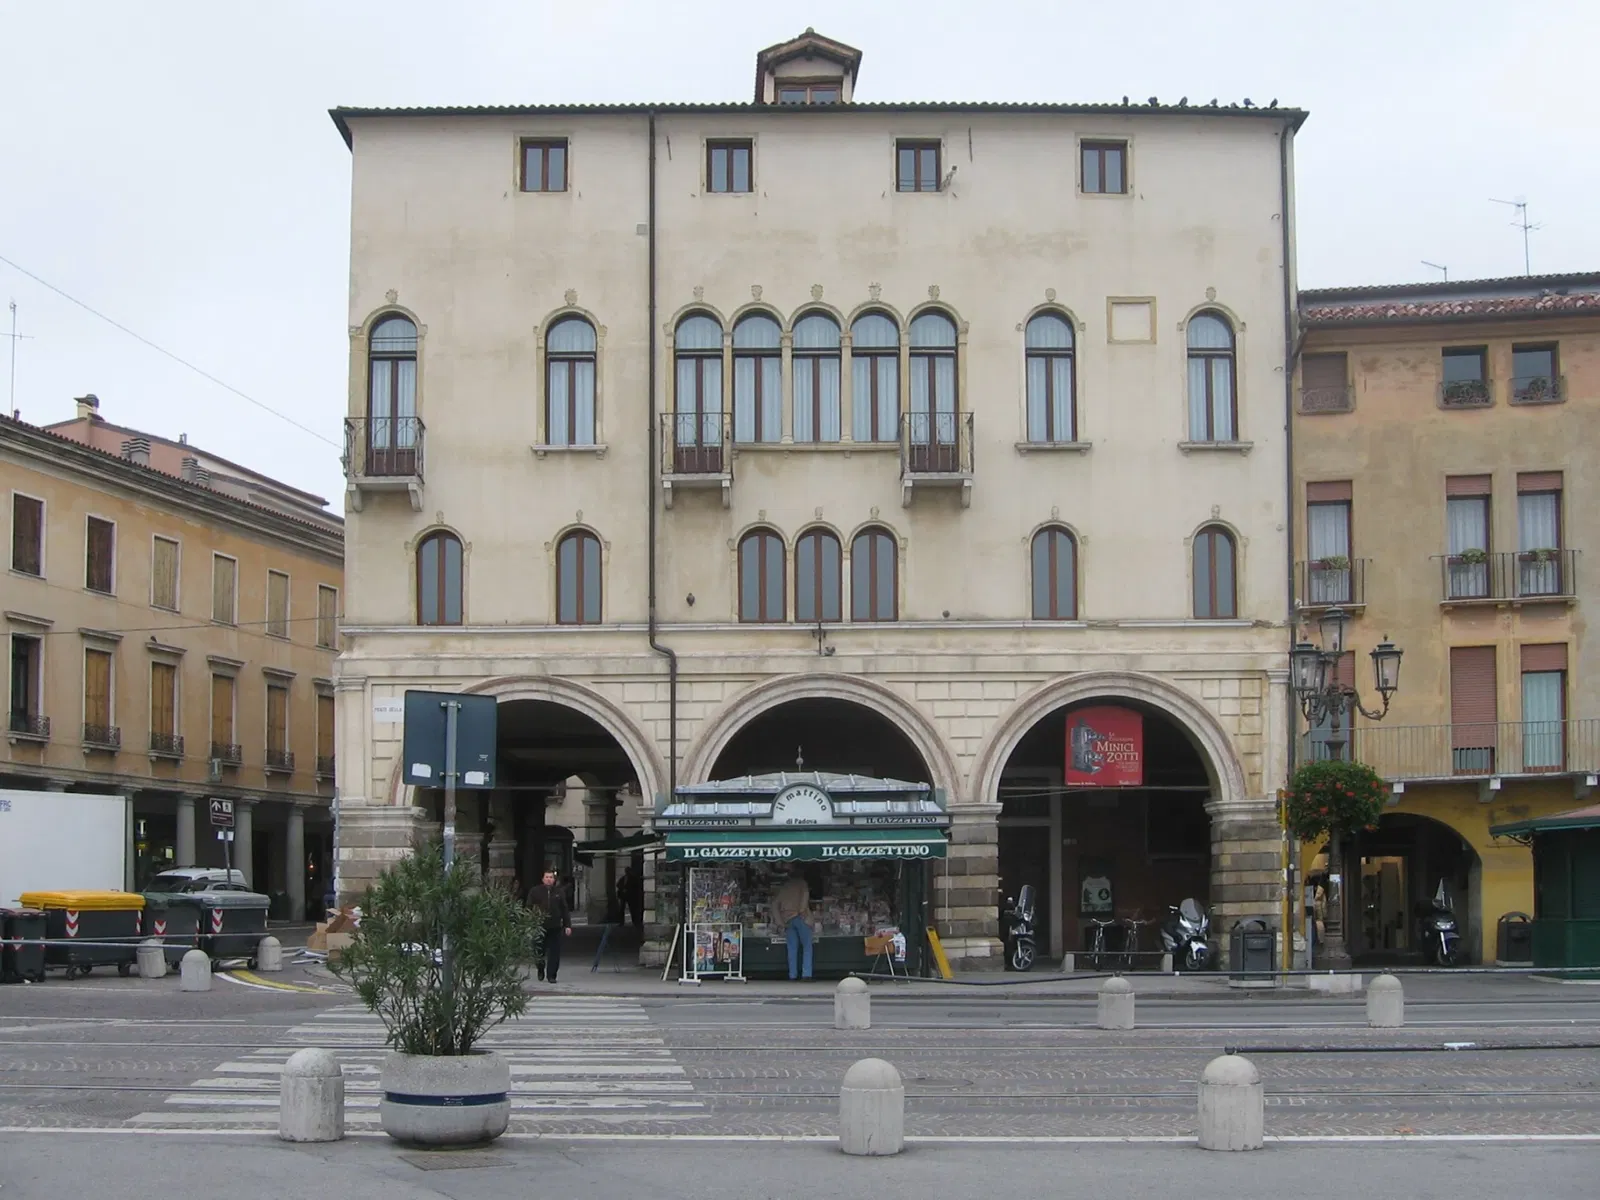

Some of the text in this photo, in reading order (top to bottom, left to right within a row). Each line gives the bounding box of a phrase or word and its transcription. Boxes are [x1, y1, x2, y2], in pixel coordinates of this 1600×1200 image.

[1096, 741, 1134, 752] MINICI
[1106, 752, 1139, 763] ZOTTI
[785, 788, 827, 811] mattino
[866, 816, 937, 824] IL GAZZETTINO
[683, 847, 792, 858] IL GAZZETTINO
[822, 845, 930, 857] IL GAZZETTINO
